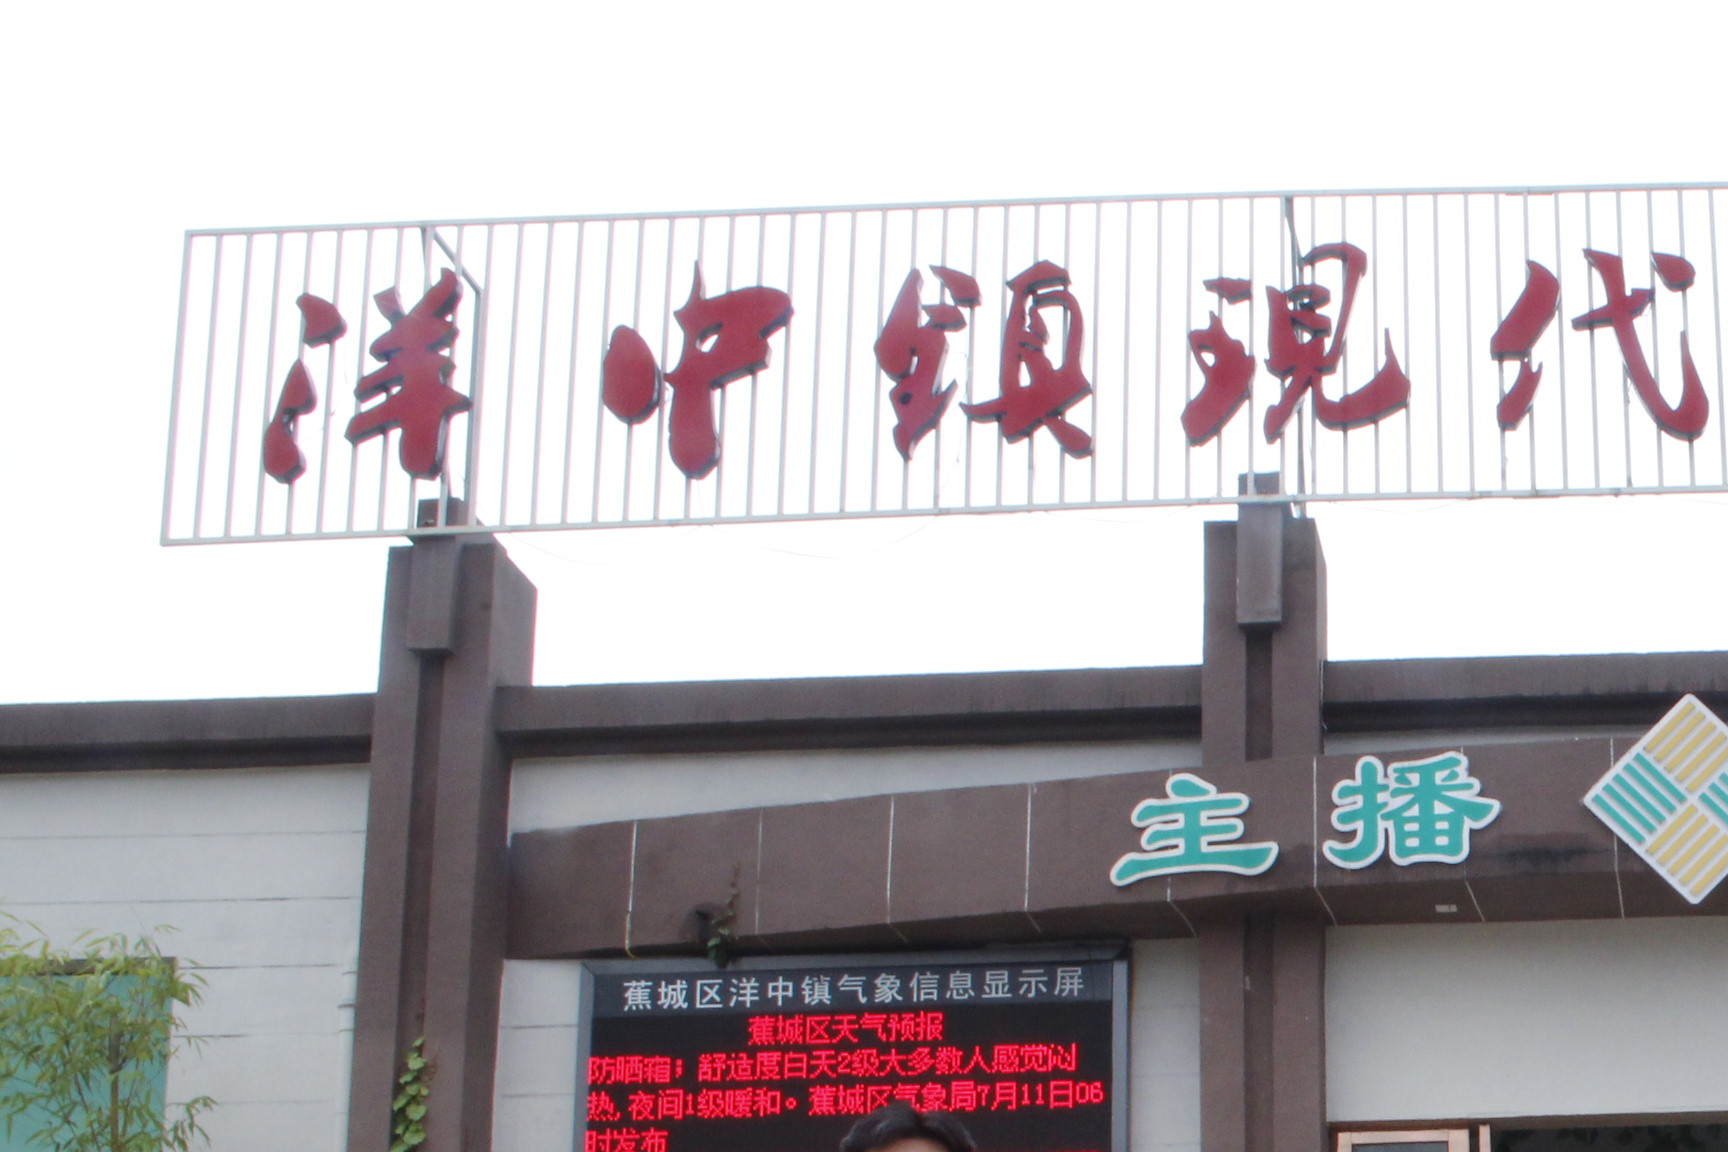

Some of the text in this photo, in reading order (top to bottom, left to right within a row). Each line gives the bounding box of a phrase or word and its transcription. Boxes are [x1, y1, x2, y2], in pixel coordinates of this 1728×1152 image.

[1110, 750, 1502, 887] 主播
[622, 966, 1086, 1012] 蕉城区洋中镇气象信息显示屏
[747, 1011, 945, 1047] 蕉城区天气预报
